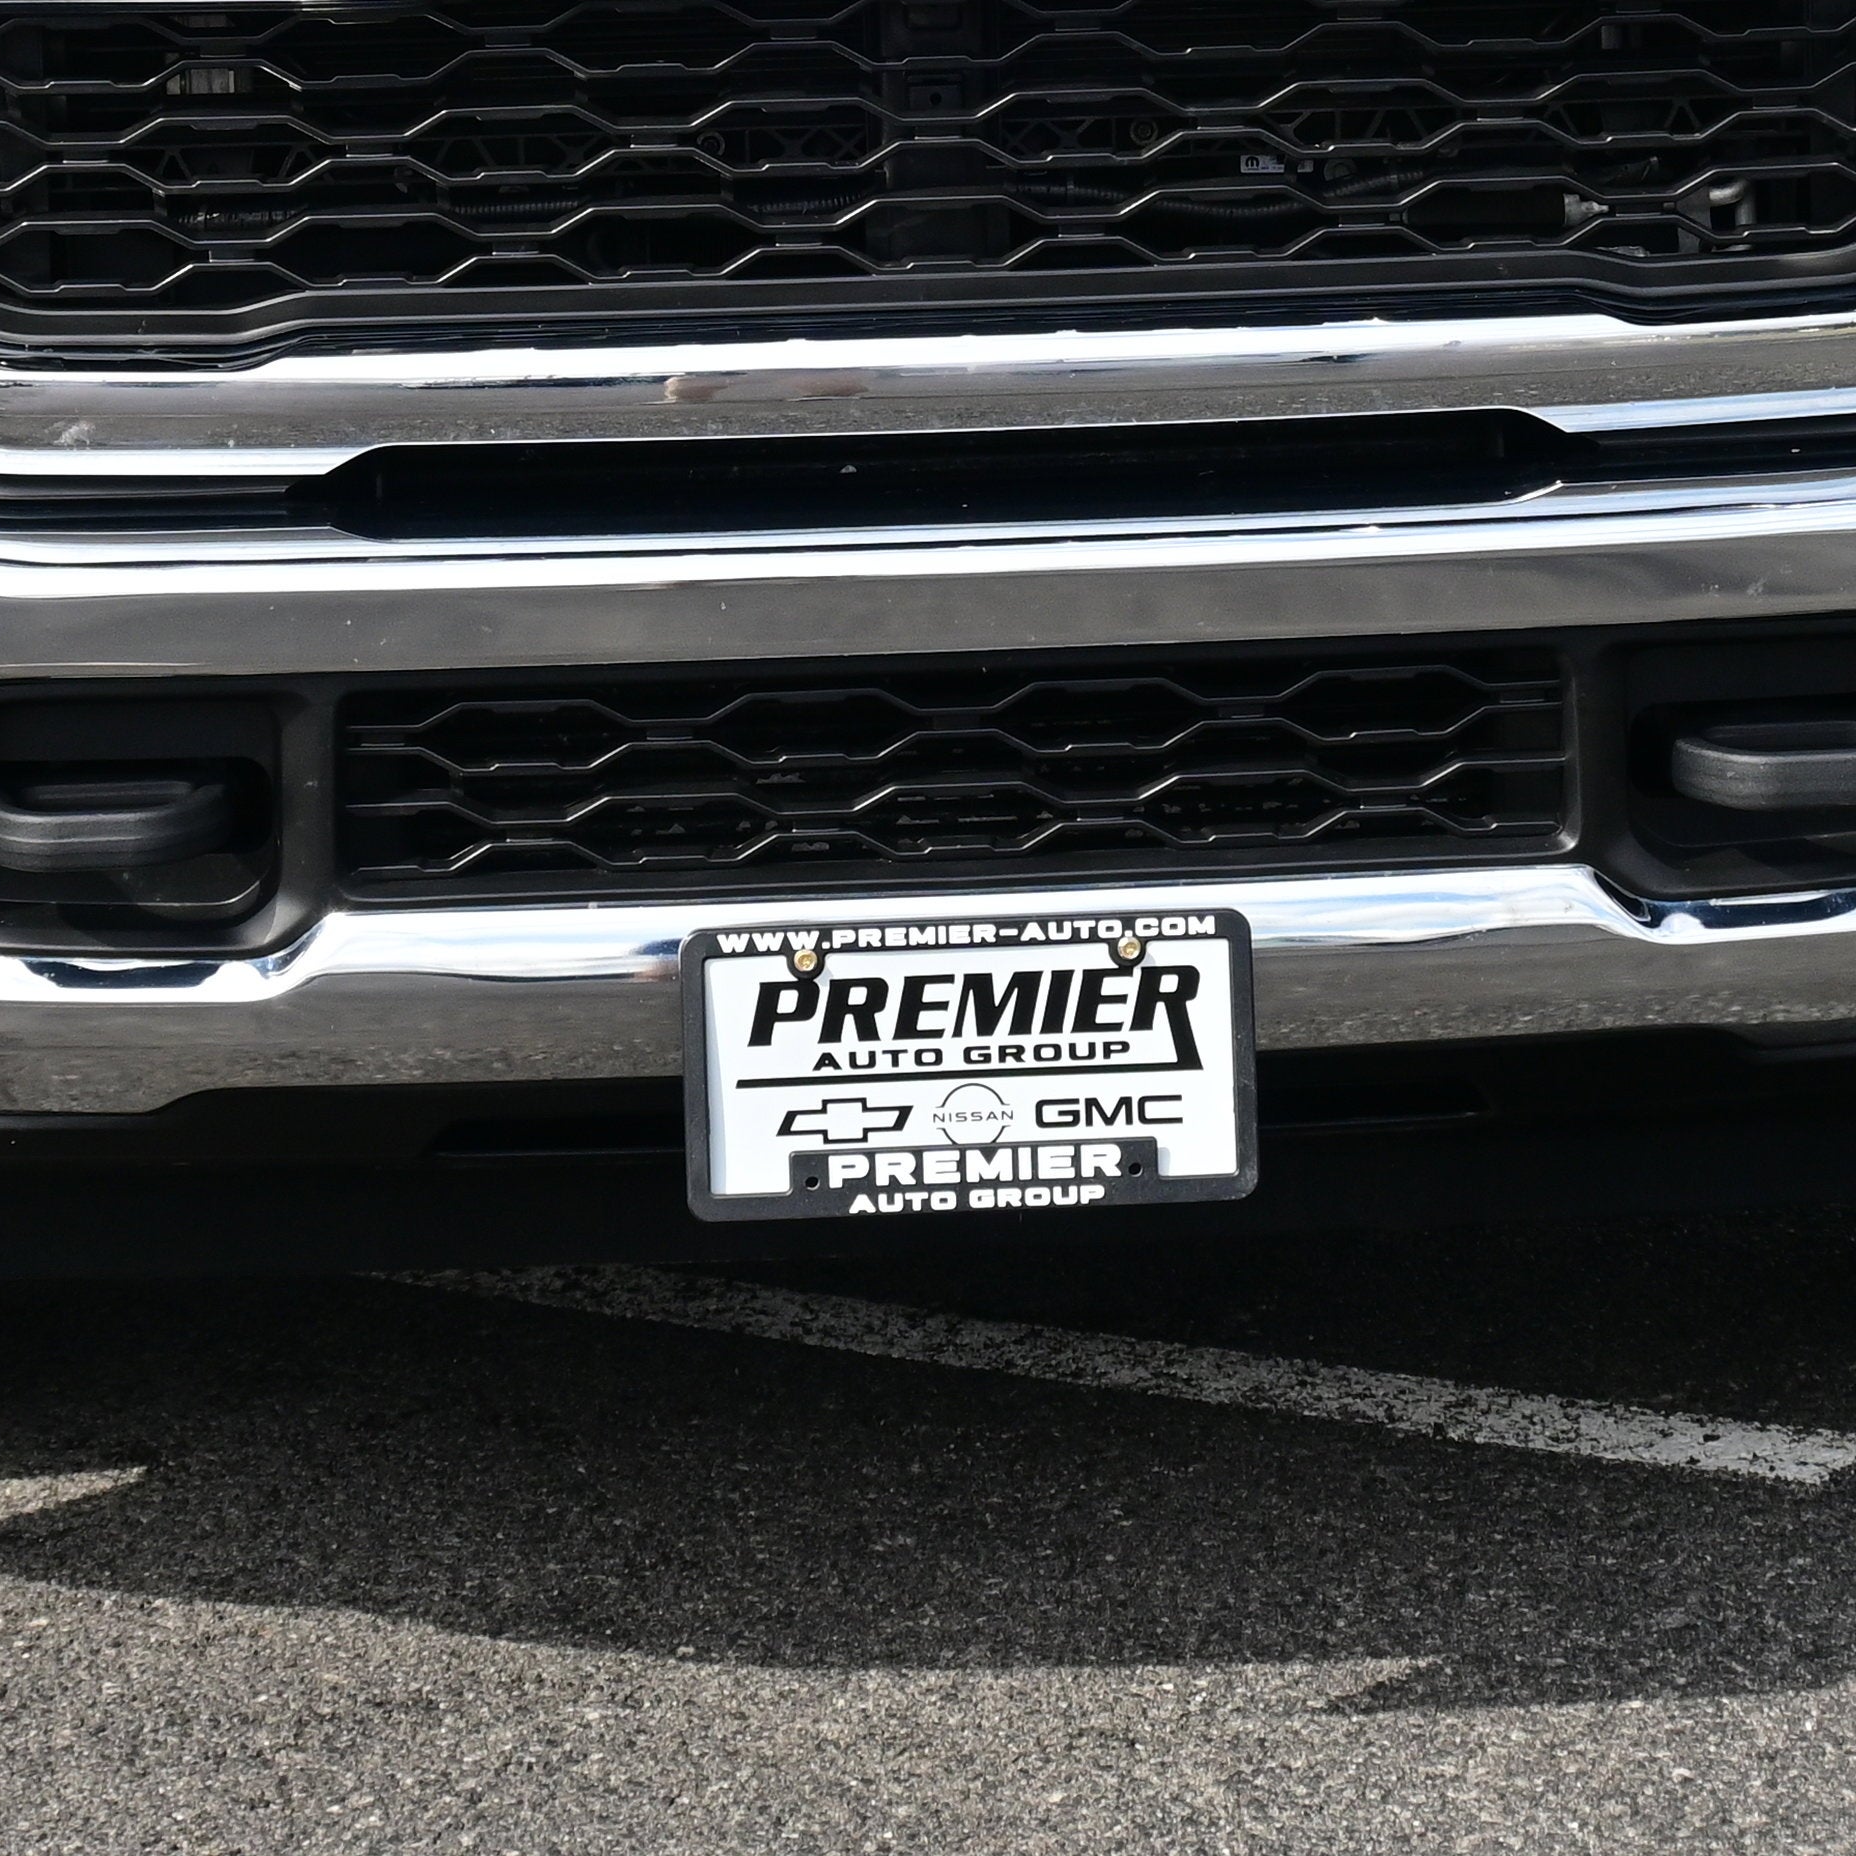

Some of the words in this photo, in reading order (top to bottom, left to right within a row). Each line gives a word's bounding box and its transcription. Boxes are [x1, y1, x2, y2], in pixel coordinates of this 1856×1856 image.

[717, 915, 1218, 954] WWW.PREMIER-AUTO.COM
[747, 964, 1204, 1071] PREMIER
[812, 1048, 944, 1072] AUTO
[962, 1041, 1131, 1066] GROUP
[932, 1108, 1015, 1125] NISSAN
[1035, 1095, 1184, 1128] GMC
[827, 1143, 1123, 1189] PREMIER
[848, 1189, 958, 1215] AUTO
[969, 1183, 1106, 1210] GROUP
